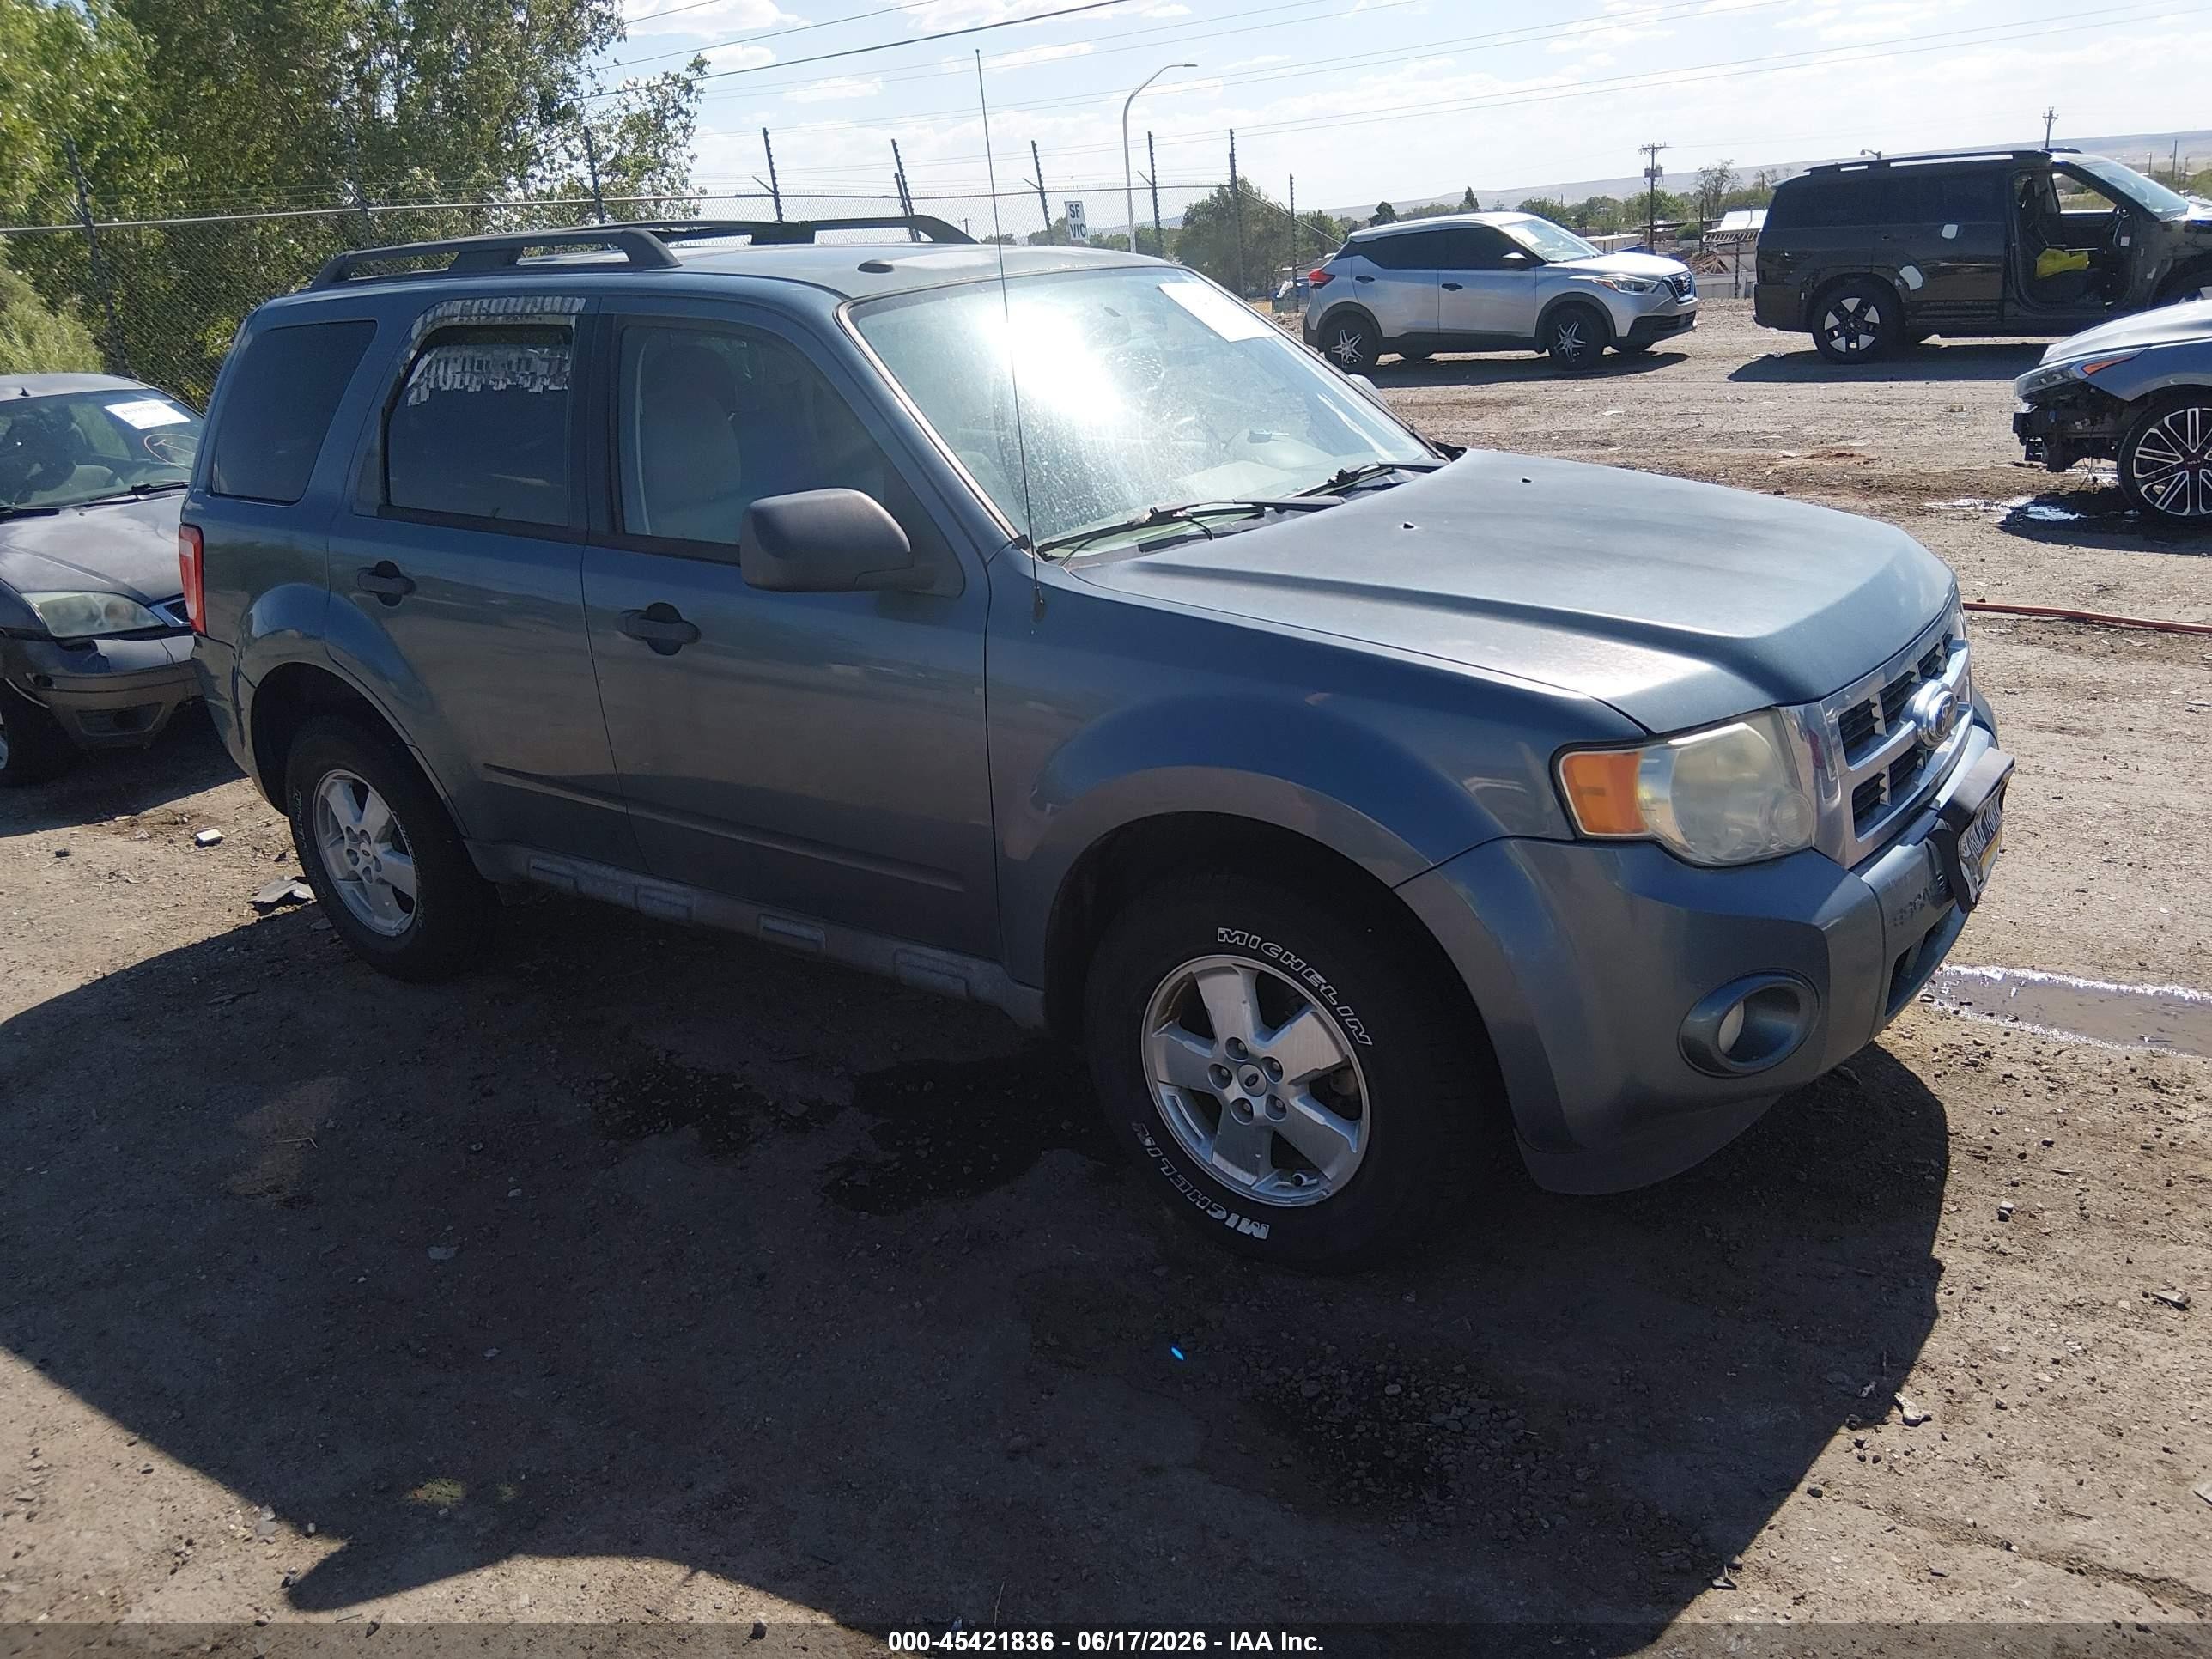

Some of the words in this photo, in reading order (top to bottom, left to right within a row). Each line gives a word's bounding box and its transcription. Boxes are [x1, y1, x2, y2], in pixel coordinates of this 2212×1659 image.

[1069, 204, 1081, 219] SF
[1069, 223, 1086, 238] VIC
[1217, 927, 1373, 1046] MICHELIN
[1132, 1121, 1270, 1240] MICHELIN
